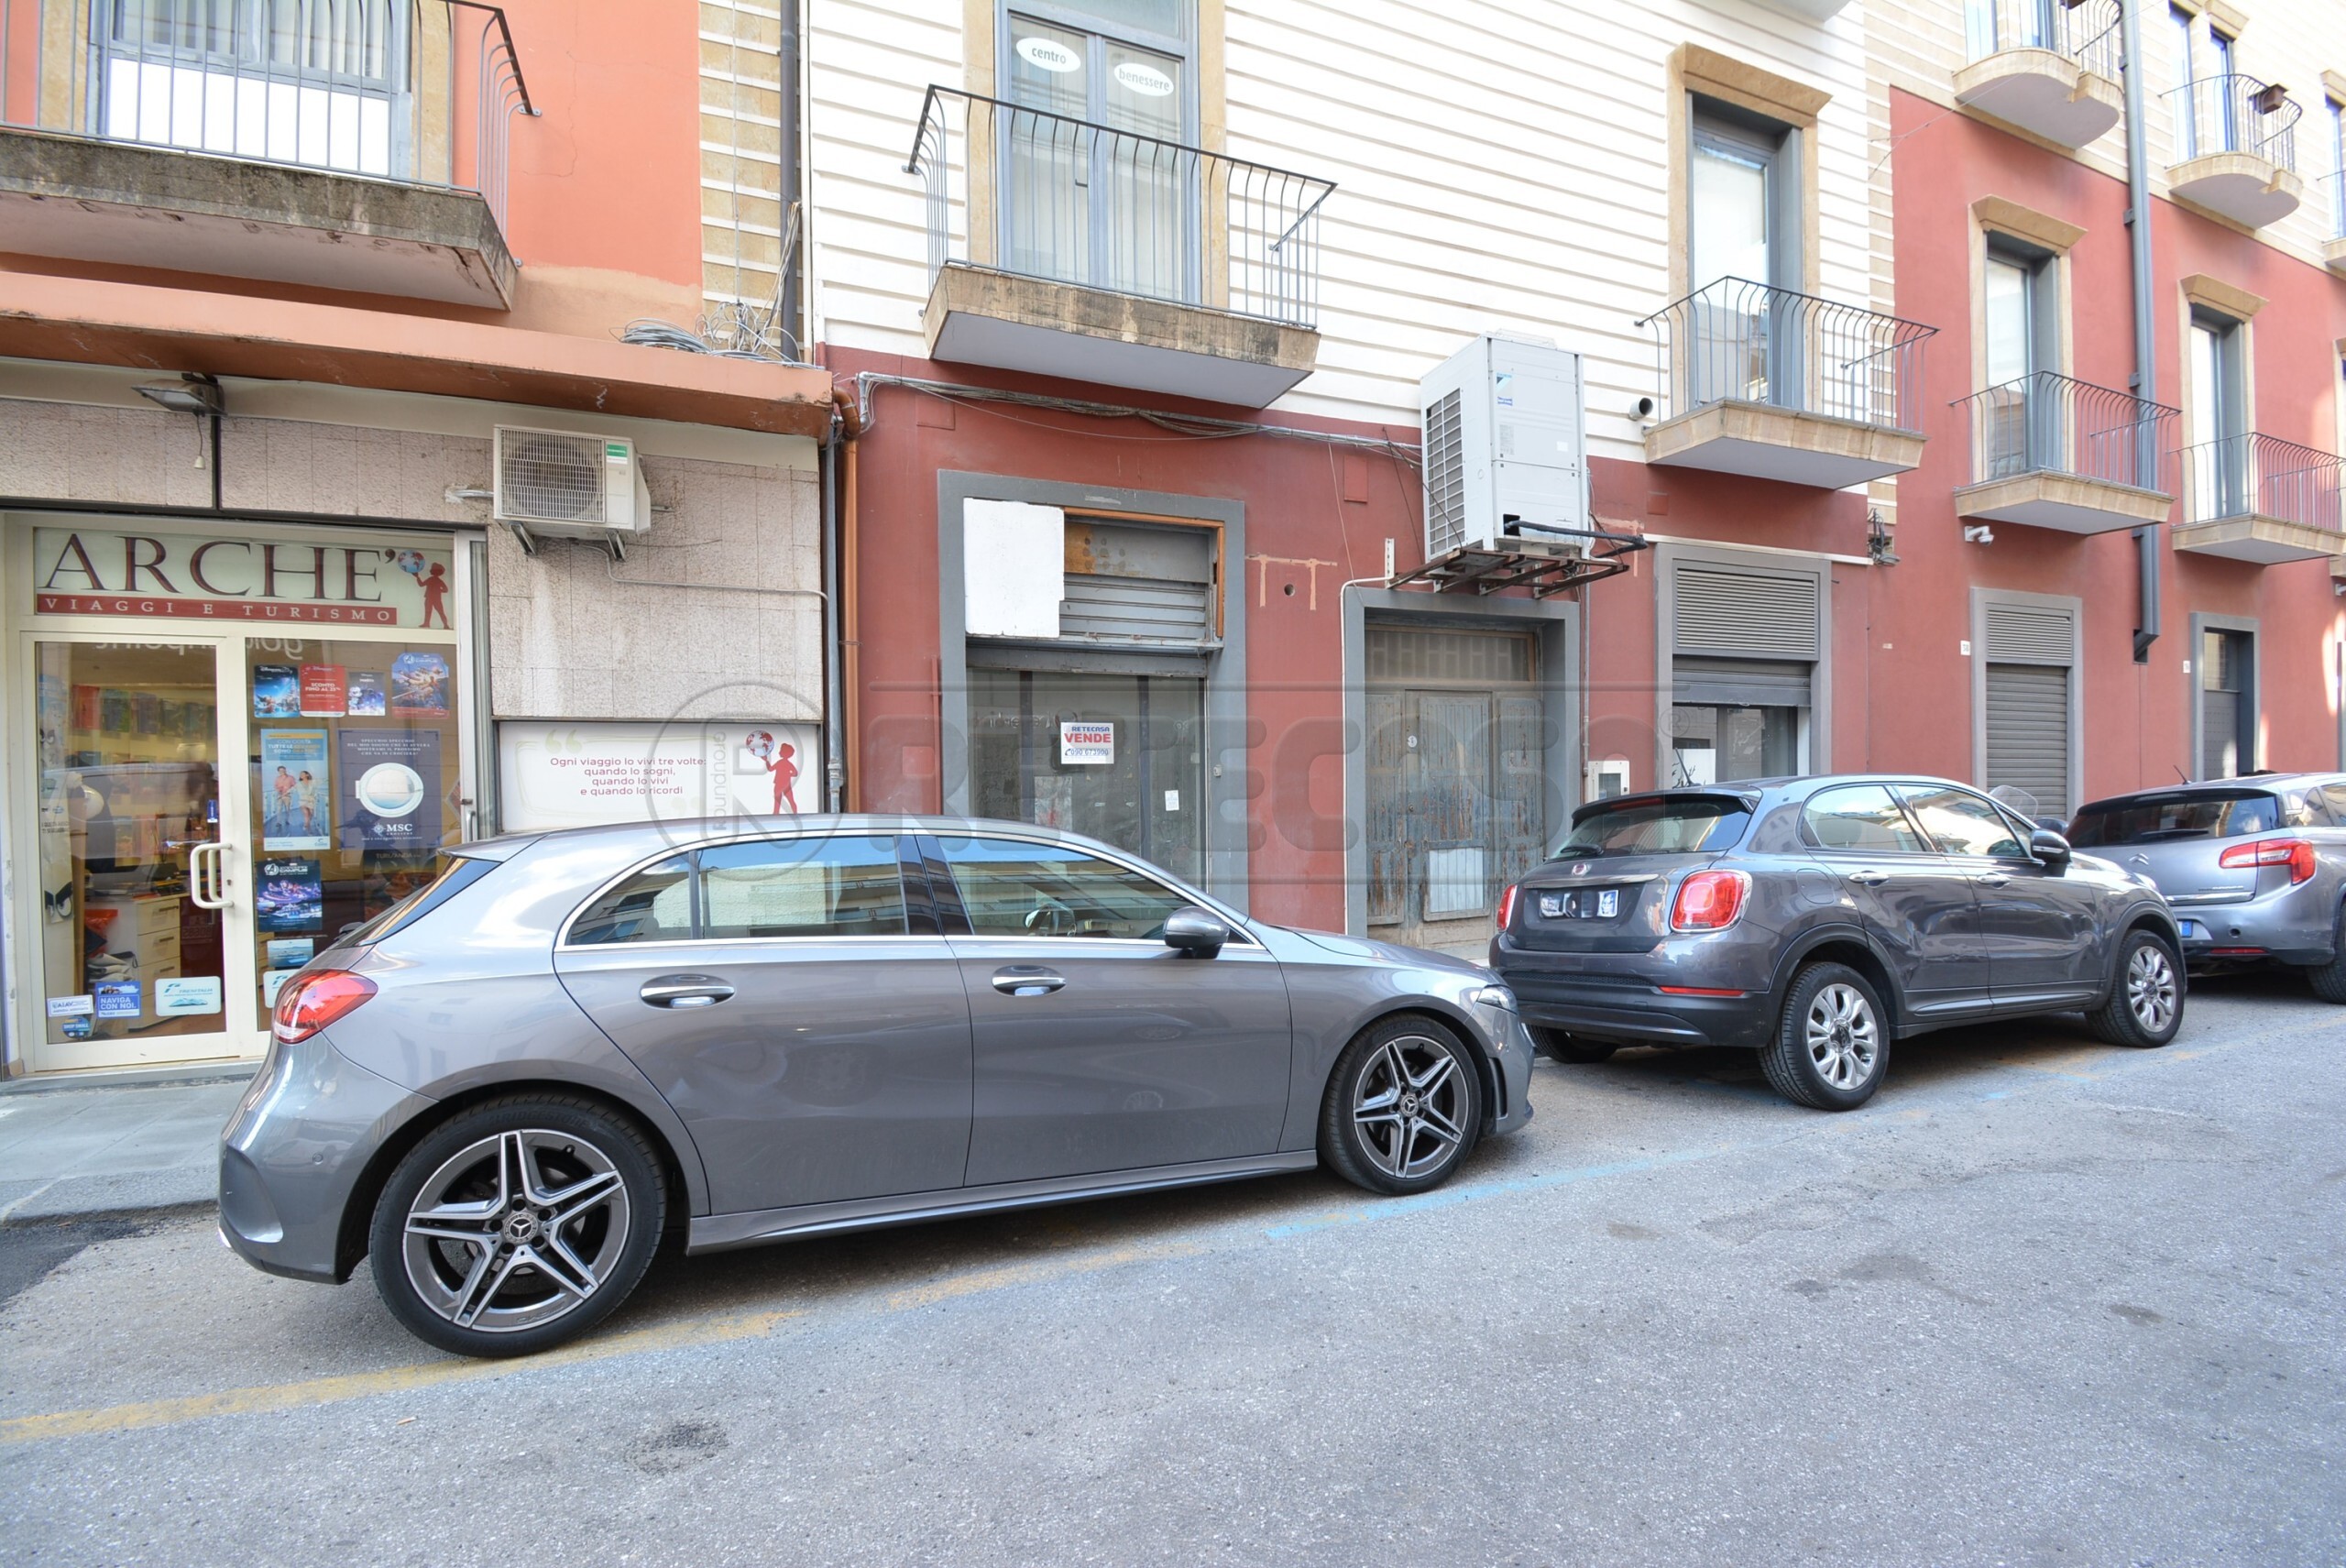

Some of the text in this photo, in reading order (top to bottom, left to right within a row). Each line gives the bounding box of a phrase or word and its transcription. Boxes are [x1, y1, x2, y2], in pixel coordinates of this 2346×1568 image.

[1033, 49, 1066, 65] centro
[1119, 71, 1169, 92] benessere
[45, 598, 390, 621] VIAGGI E TURISMO
[1063, 732, 1112, 743] VENDE
[1070, 748, 1083, 756] 090
[550, 757, 577, 767] Ogni
[580, 757, 621, 767] viaggio
[624, 757, 634, 766] lo
[637, 757, 656, 766] vivi
[677, 757, 707, 766] volte:
[584, 767, 675, 776] quando lo sogni,
[592, 776, 669, 786] quando lo vivi
[590, 787, 633, 796] quando
[636, 786, 646, 795] lo
[649, 786, 683, 795] ricordi
[386, 823, 413, 832] MSC
